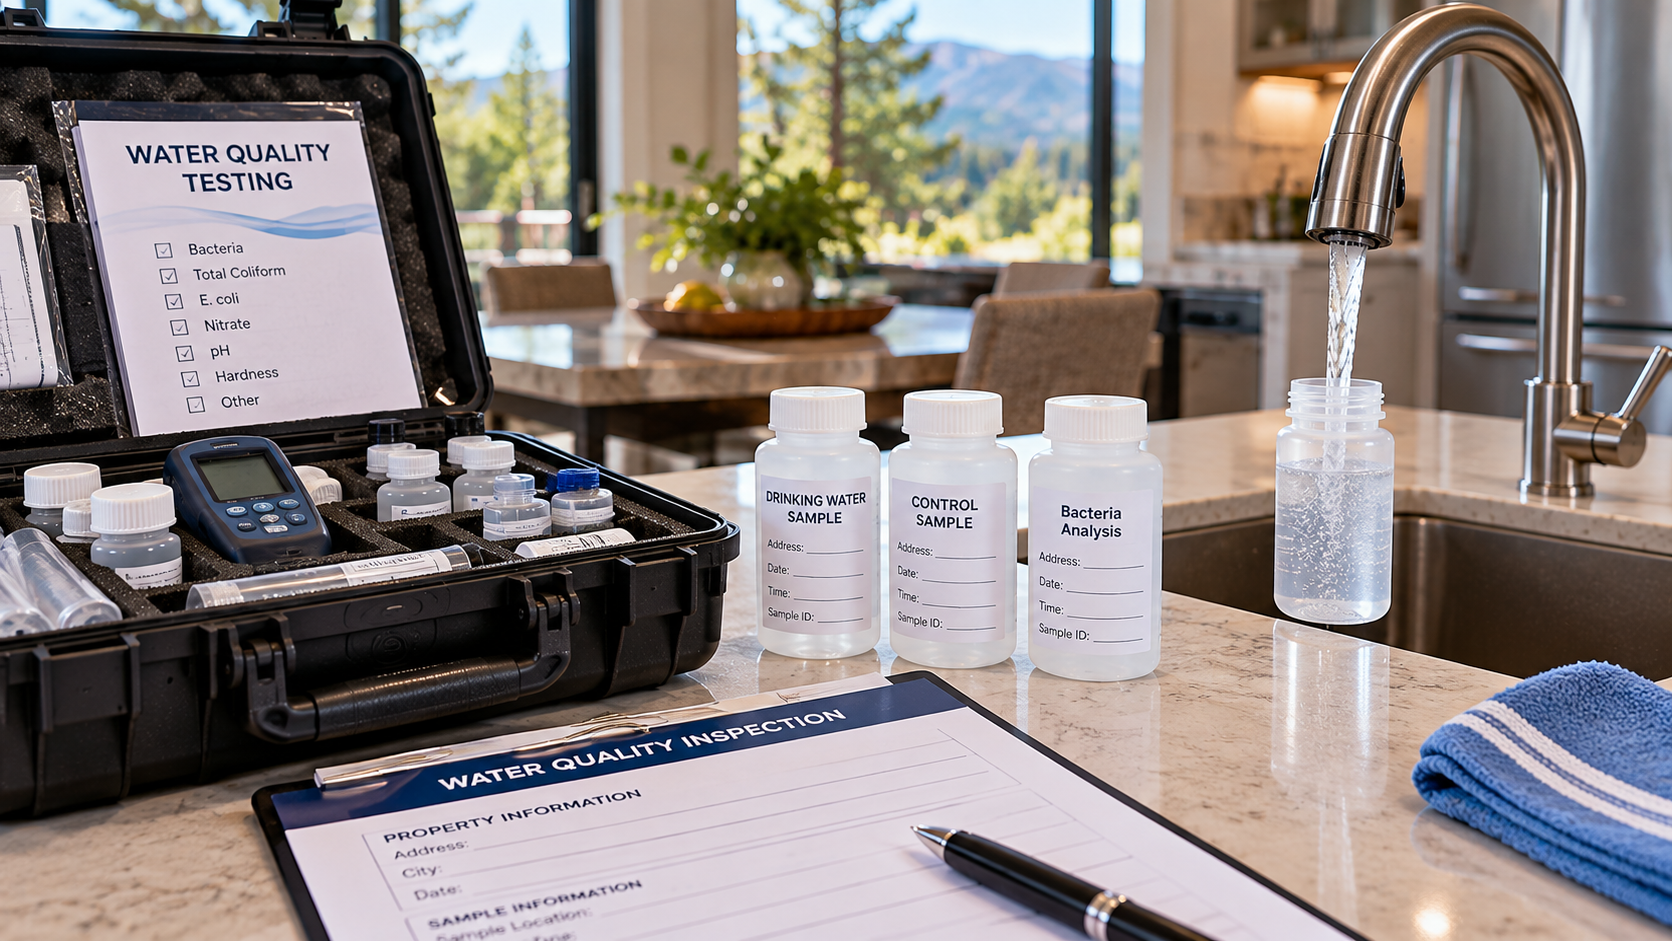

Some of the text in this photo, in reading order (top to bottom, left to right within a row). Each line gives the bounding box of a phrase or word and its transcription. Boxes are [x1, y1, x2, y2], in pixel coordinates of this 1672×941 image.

[125, 144, 330, 164] WATER QUALITY
[182, 172, 293, 192] TESTING
[188, 242, 244, 256] Bacteria
[193, 265, 286, 281] Total Coliform
[199, 293, 240, 306] E. coli
[204, 318, 251, 332] Nitrate
[210, 344, 231, 360] pH
[215, 368, 279, 383] Hardness
[221, 395, 260, 409] Other
[766, 490, 866, 507] DRINKING WATER
[911, 495, 979, 511] CONTROL
[787, 510, 843, 524] SAMPLE
[1060, 504, 1122, 520] Bacteria
[916, 513, 973, 529] SAMPLE
[1060, 523, 1122, 541] Analysis
[767, 539, 804, 553] Address:
[897, 541, 934, 557] Address:
[1039, 551, 1081, 567] Address:
[767, 562, 790, 575] Date:
[897, 565, 919, 579] Date:
[1039, 575, 1064, 590] Date:
[767, 585, 791, 599] Time:
[897, 588, 920, 603] Time:
[768, 606, 815, 622] Sample ID:
[1039, 600, 1064, 615] Time:
[897, 610, 943, 629] Sample ID:
[1039, 622, 1090, 641] Sample ID:
[437, 708, 847, 791] WATER QUALITY INSPECTION
[383, 789, 642, 844] PROPERTY INFORMATION
[394, 840, 470, 860] Address:
[401, 864, 443, 879] City:
[413, 884, 463, 901] Date:
[427, 879, 643, 931] SAMPLE INFORMATION
[510, 907, 592, 933] Location:
